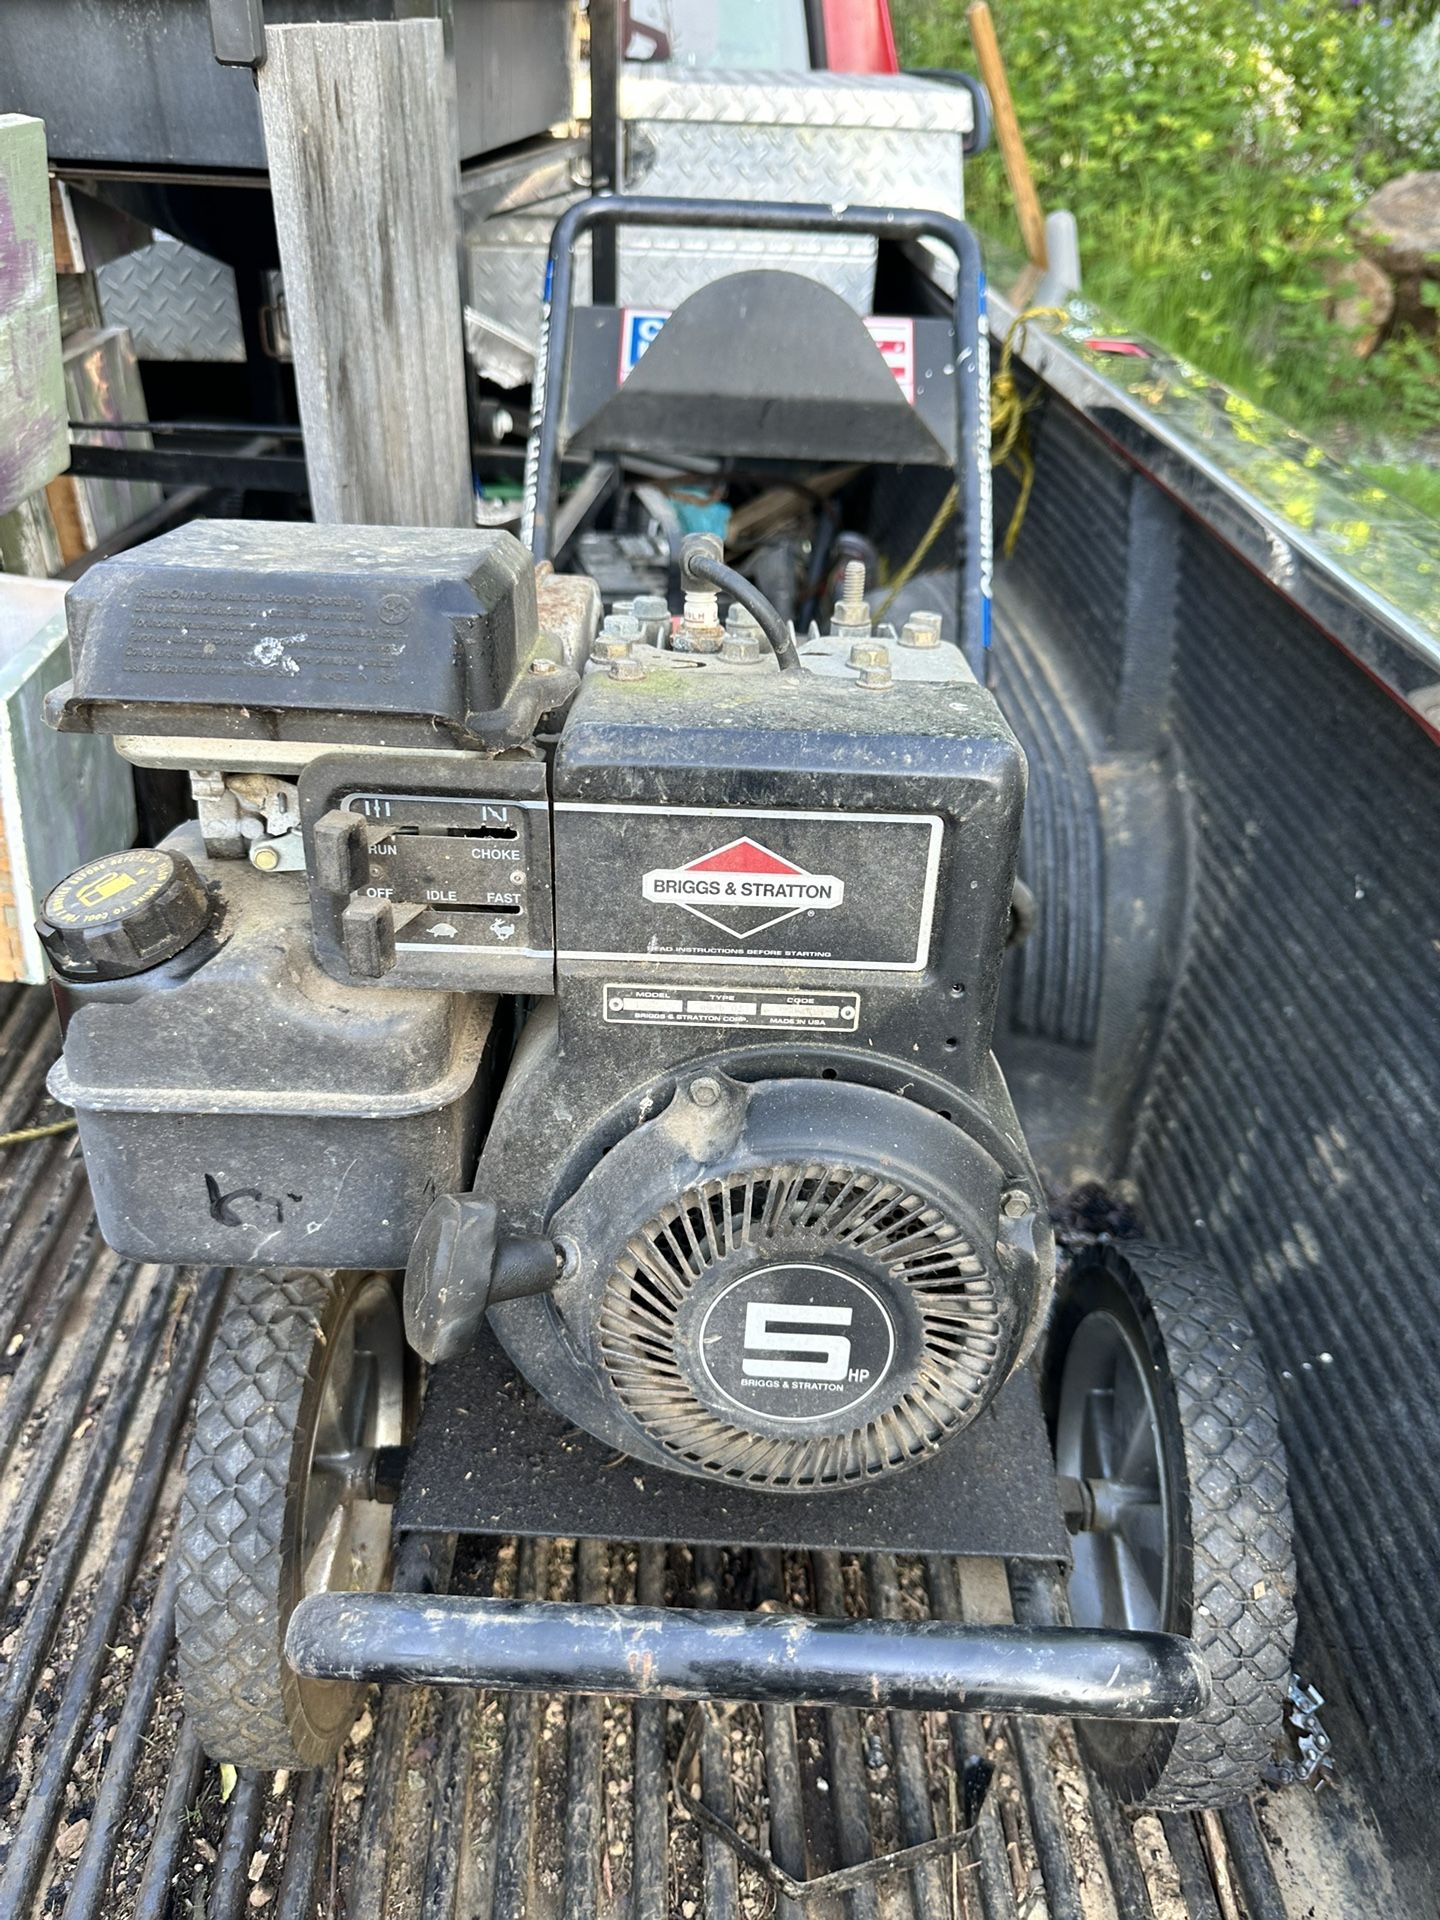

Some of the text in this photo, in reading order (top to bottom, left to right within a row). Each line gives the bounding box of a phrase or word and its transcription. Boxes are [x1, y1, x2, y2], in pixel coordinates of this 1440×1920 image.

[368, 845, 520, 861] RUN CHOKE
[366, 887, 521, 904] OFF IDLE FAST
[653, 879, 832, 899] BRIGGS & STRATTON
[676, 946, 744, 955] INSTRUCTIONS
[634, 1012, 666, 1020] BRIGGS
[808, 1018, 826, 1026] USA
[742, 1301, 870, 1383] 5 HP
[740, 1378, 844, 1392] BRIGGS & STRATTON
